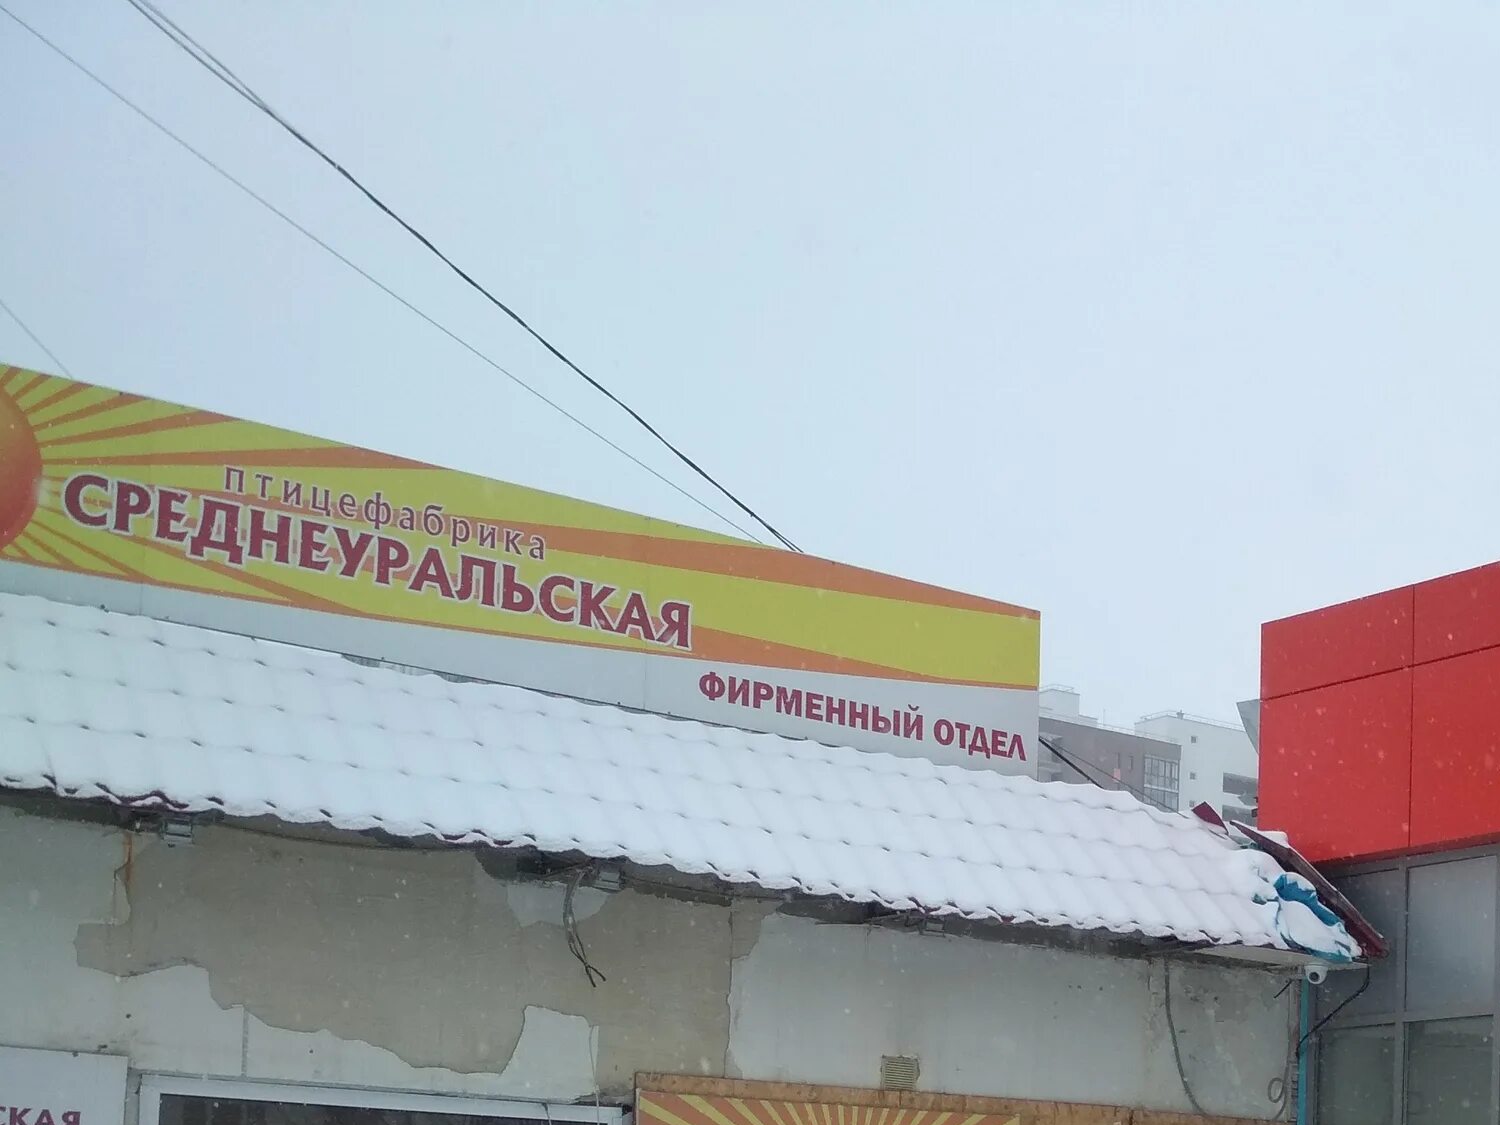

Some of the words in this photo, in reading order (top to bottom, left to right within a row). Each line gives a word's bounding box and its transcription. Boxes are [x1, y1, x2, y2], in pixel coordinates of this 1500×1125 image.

[224, 466, 546, 560] птицефабрика
[63, 474, 693, 649] СРЕДНЕУРАЛЬСКАЯ
[699, 671, 924, 742] ФИРМЕННЫЙ
[933, 719, 1027, 761] ОТДЕЛ
